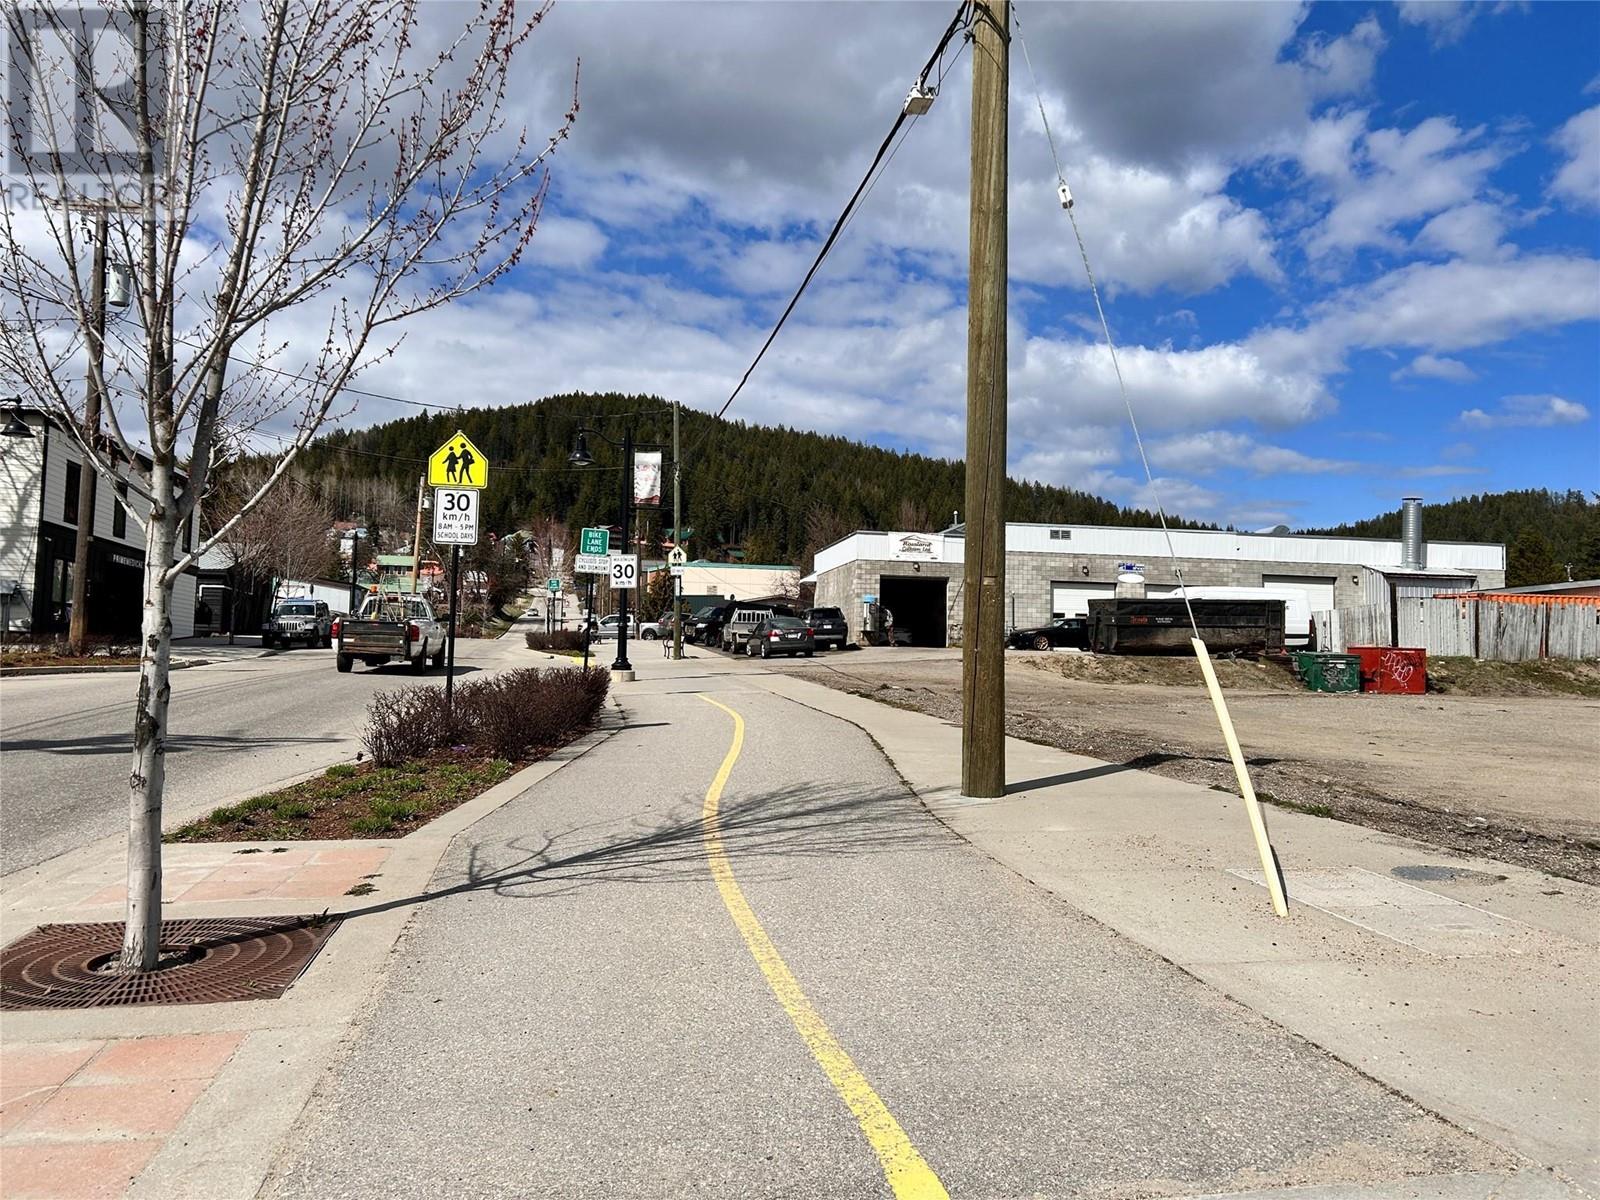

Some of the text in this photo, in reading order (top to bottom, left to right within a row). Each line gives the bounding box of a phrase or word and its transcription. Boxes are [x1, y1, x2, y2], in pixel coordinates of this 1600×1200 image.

[443, 493, 470, 511] 30
[442, 512, 470, 521] km/h
[437, 531, 474, 540] SCHOOL DAYS
[588, 531, 603, 539] BIKE
[587, 538, 603, 546] LANE
[586, 545, 602, 553] ENDS
[612, 563, 635, 579] 30
